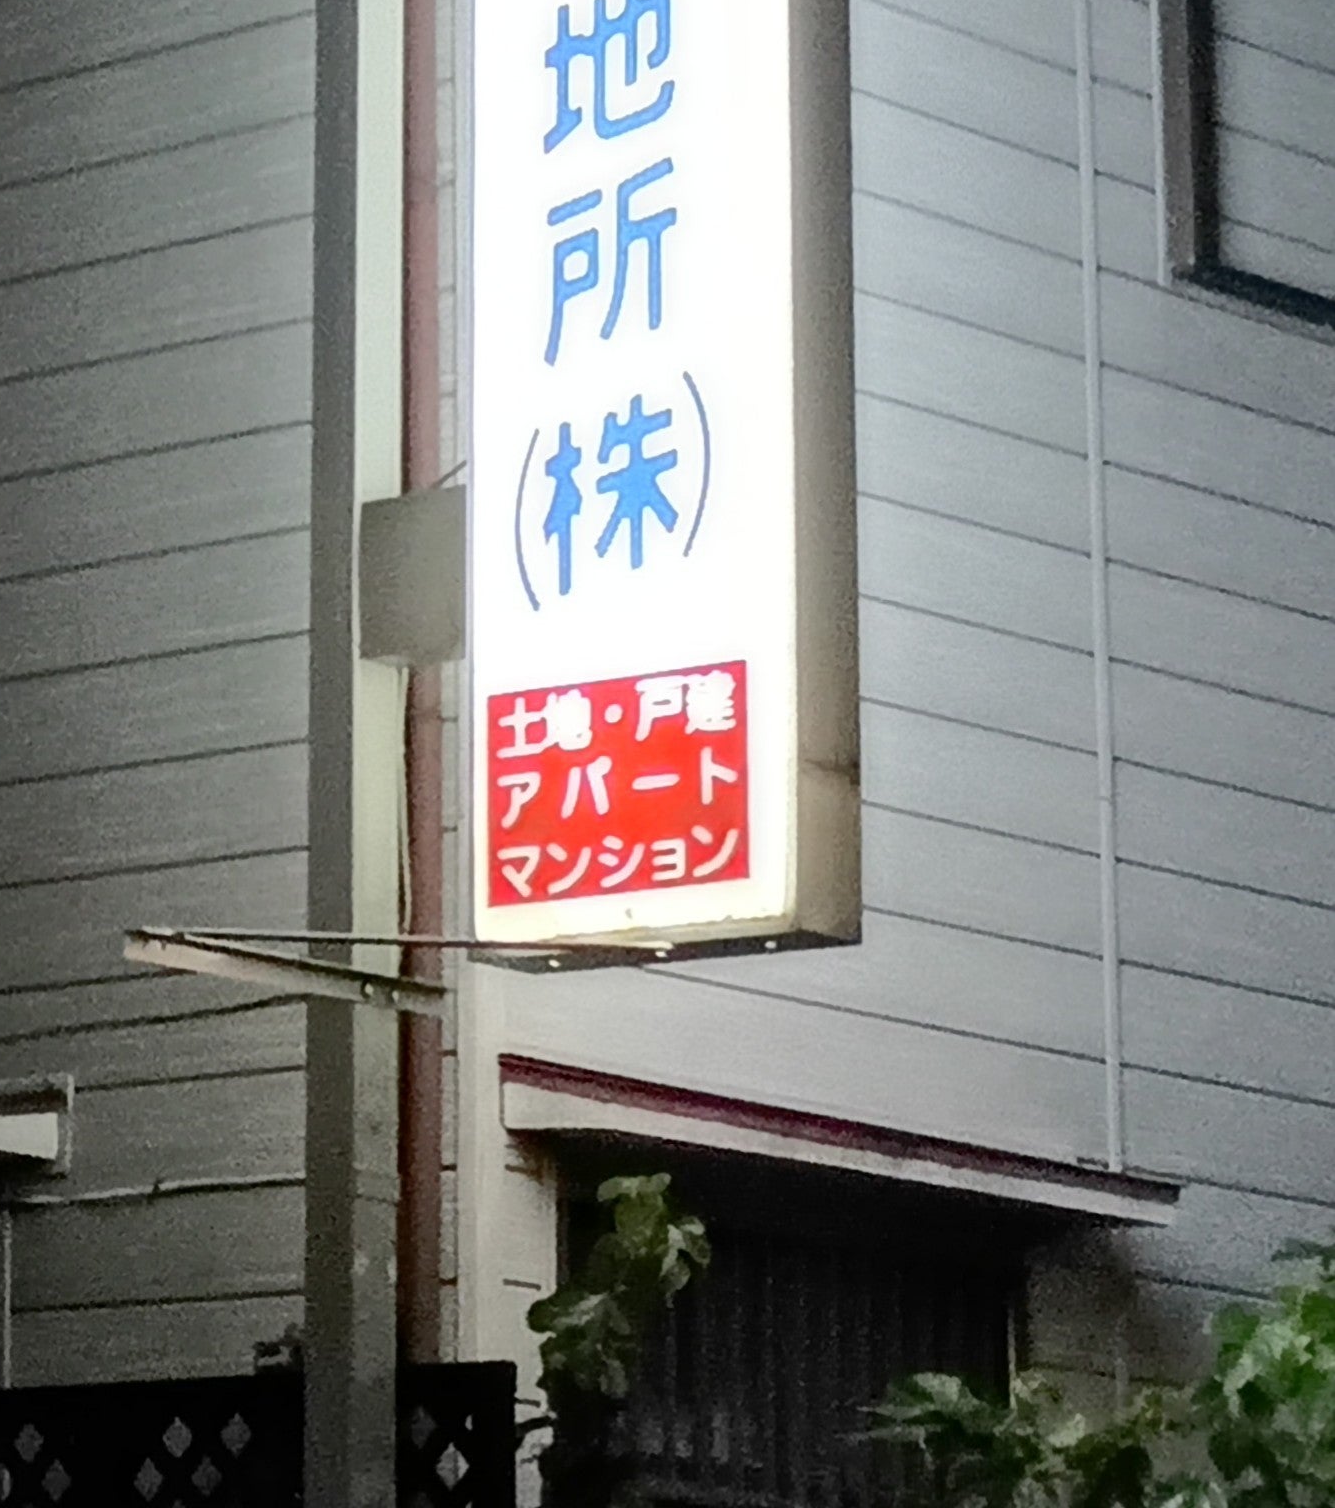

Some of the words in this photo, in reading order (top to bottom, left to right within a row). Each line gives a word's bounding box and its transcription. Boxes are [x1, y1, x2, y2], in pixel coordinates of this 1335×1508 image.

[497, 746, 738, 829] アパート
[496, 825, 739, 898] マンション
